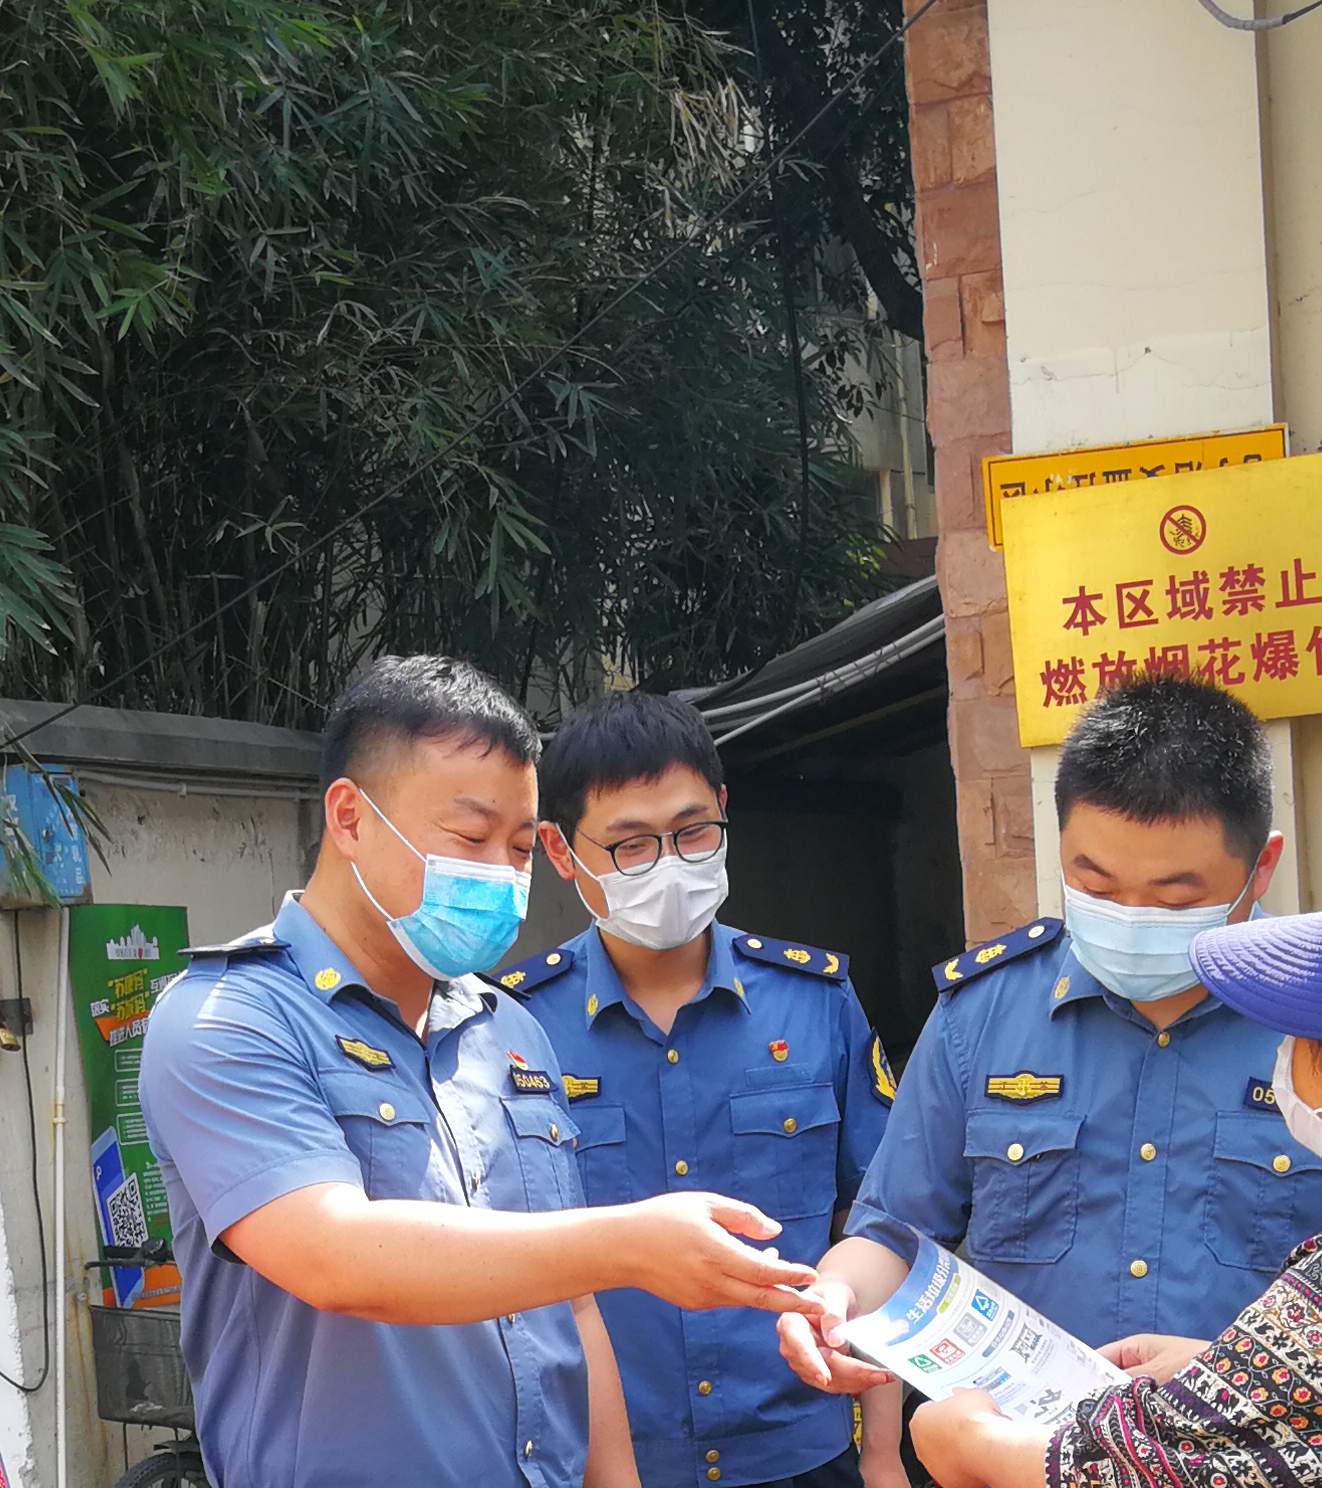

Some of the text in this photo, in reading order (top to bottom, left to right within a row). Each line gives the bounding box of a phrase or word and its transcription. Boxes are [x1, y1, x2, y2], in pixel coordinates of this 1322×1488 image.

[1062, 557, 1322, 637] 本区域禁止
